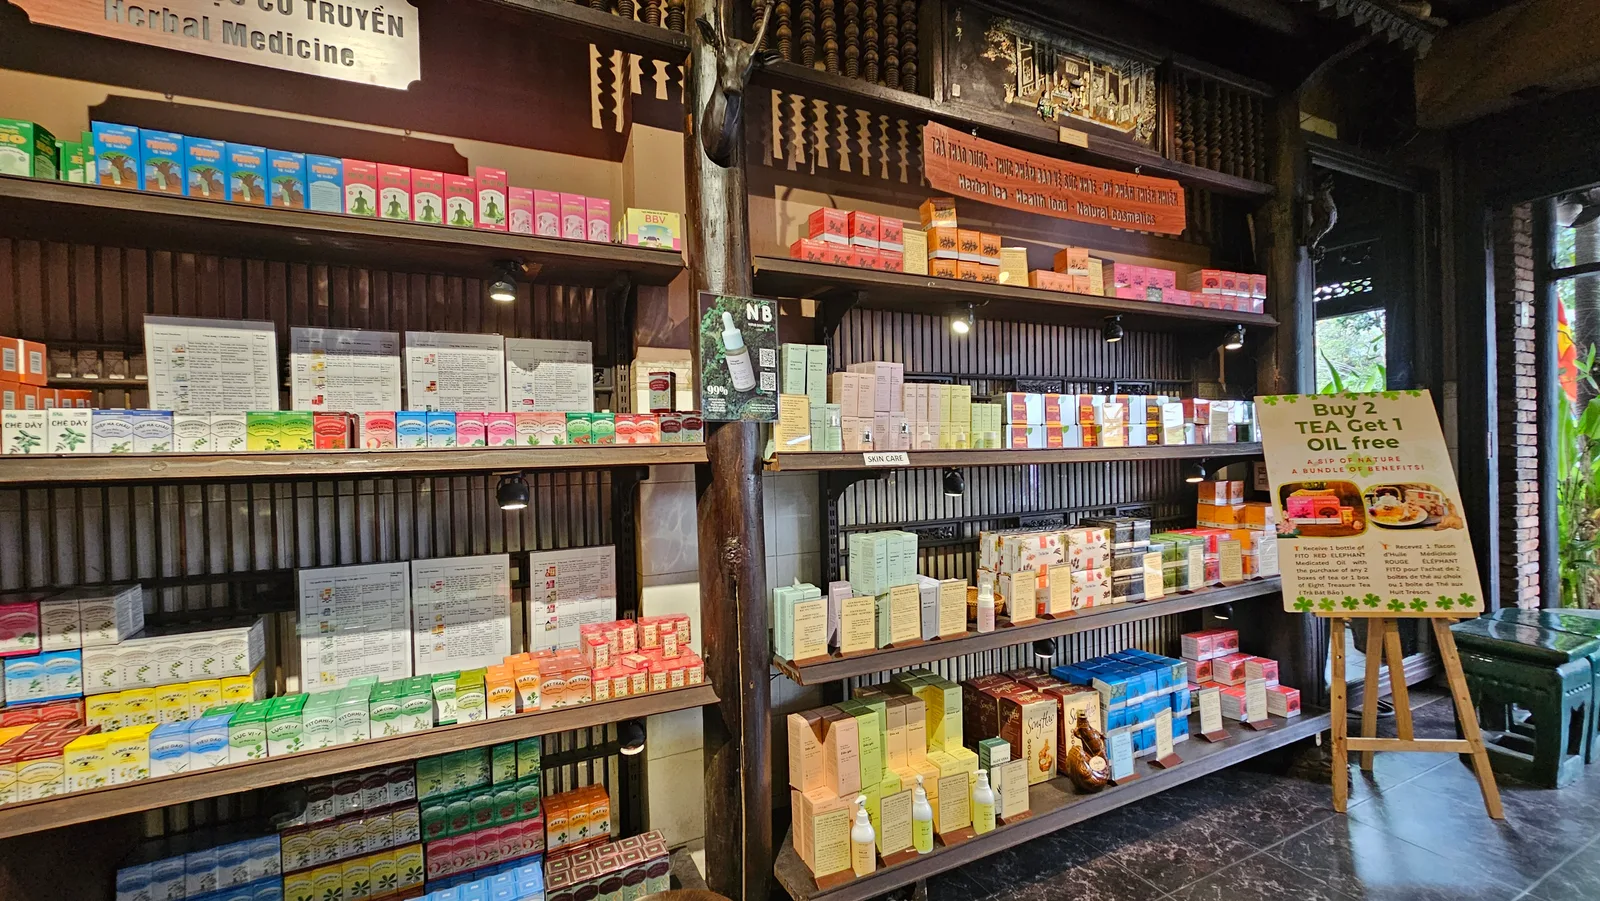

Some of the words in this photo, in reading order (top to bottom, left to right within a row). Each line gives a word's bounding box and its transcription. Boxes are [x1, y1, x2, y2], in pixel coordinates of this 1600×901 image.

[304, 0, 403, 38] TRUYỀN
[104, 0, 210, 40] Herbal
[222, 20, 354, 66] Medicine
[959, 174, 989, 195] Herbal
[992, 184, 1008, 199] tea
[1016, 189, 1045, 209] Health
[1048, 196, 1068, 212] food
[1077, 201, 1108, 219] Natural
[1111, 209, 1156, 225] cosmetics
[645, 214, 666, 224] BBV
[707, 385, 728, 396] 99%
[1313, 403, 1356, 418] Buy
[1363, 401, 1377, 415] 2
[1295, 420, 1342, 435] TEA
[1347, 419, 1386, 433] Get
[1392, 418, 1402, 430] 1
[1307, 437, 1347, 452] OIL
[1352, 436, 1400, 450] free
